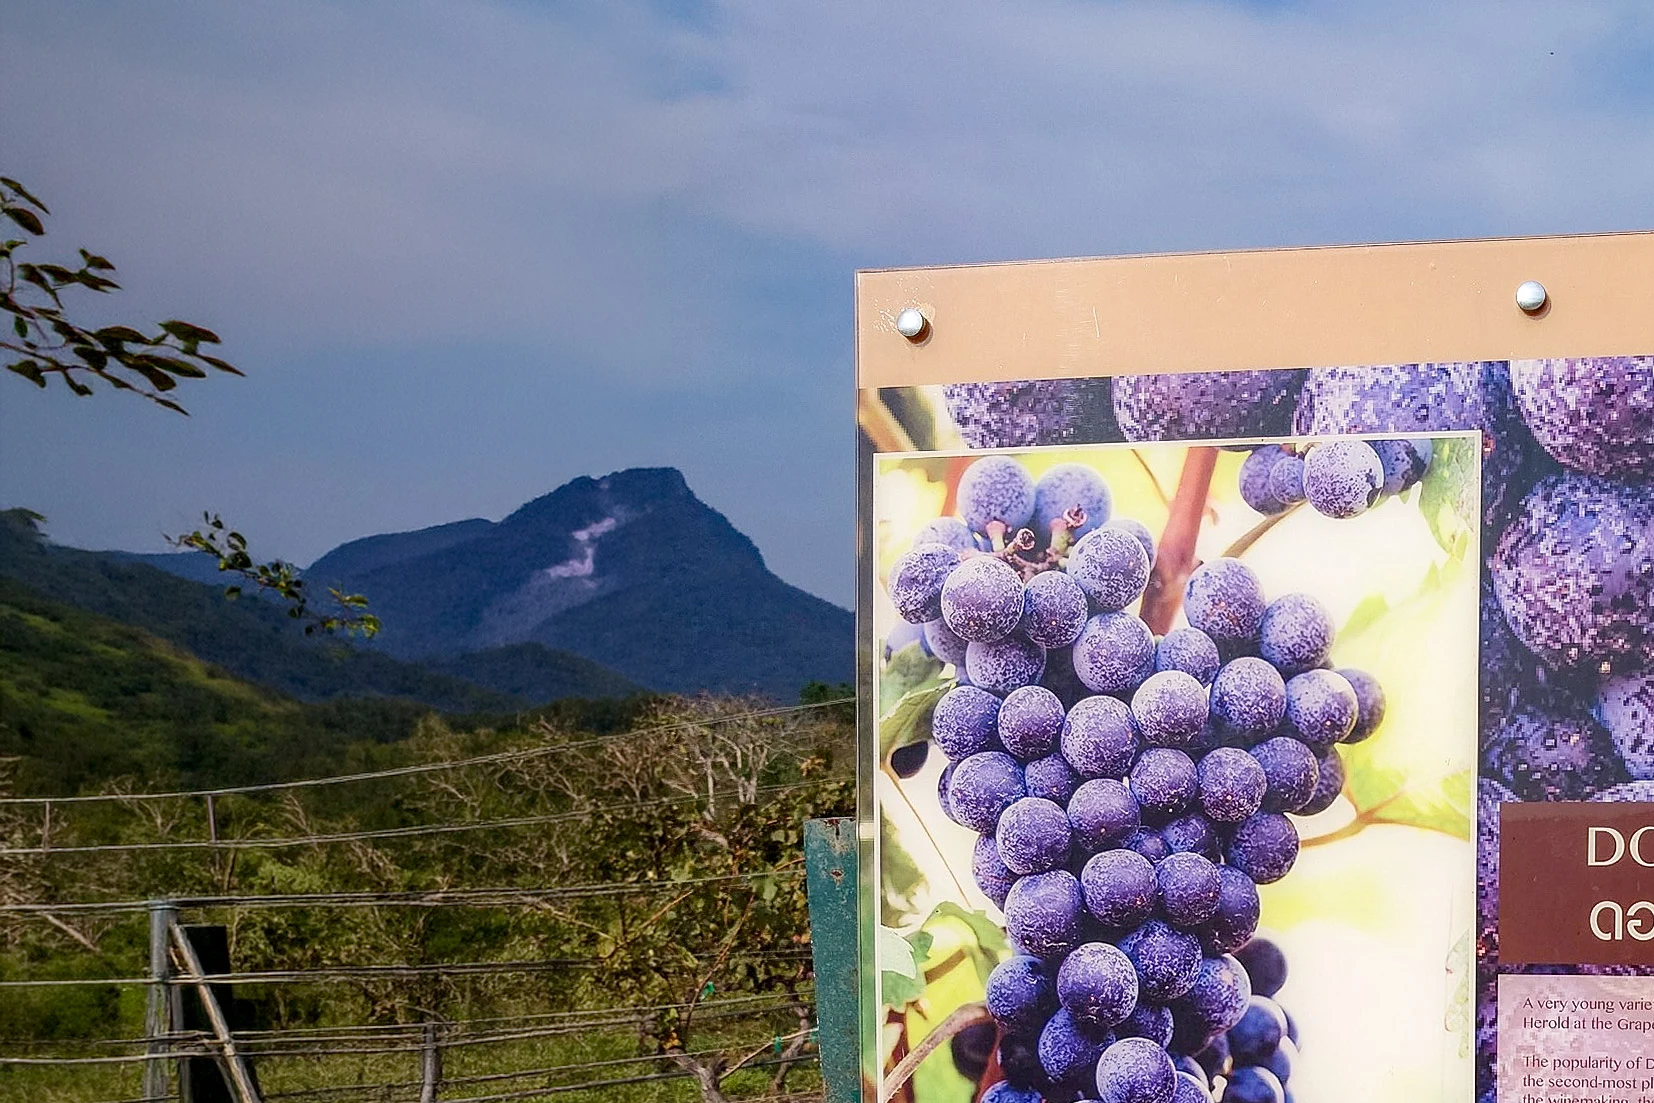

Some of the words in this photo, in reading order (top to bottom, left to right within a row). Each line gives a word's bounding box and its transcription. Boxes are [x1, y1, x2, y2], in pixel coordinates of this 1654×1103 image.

[1523, 998, 1533, 1009] A
[1537, 1000, 1566, 1012] very
[1571, 1000, 1614, 1013] young
[1523, 1016, 1569, 1029] Herold
[1574, 1019, 1586, 1029] at
[1592, 1018, 1612, 1029] the
[1523, 1055, 1548, 1068] The
[1553, 1056, 1622, 1071] popularity
[1626, 1057, 1642, 1070] of
[1523, 1075, 1544, 1087] the
[1549, 1076, 1637, 1089] second-most
